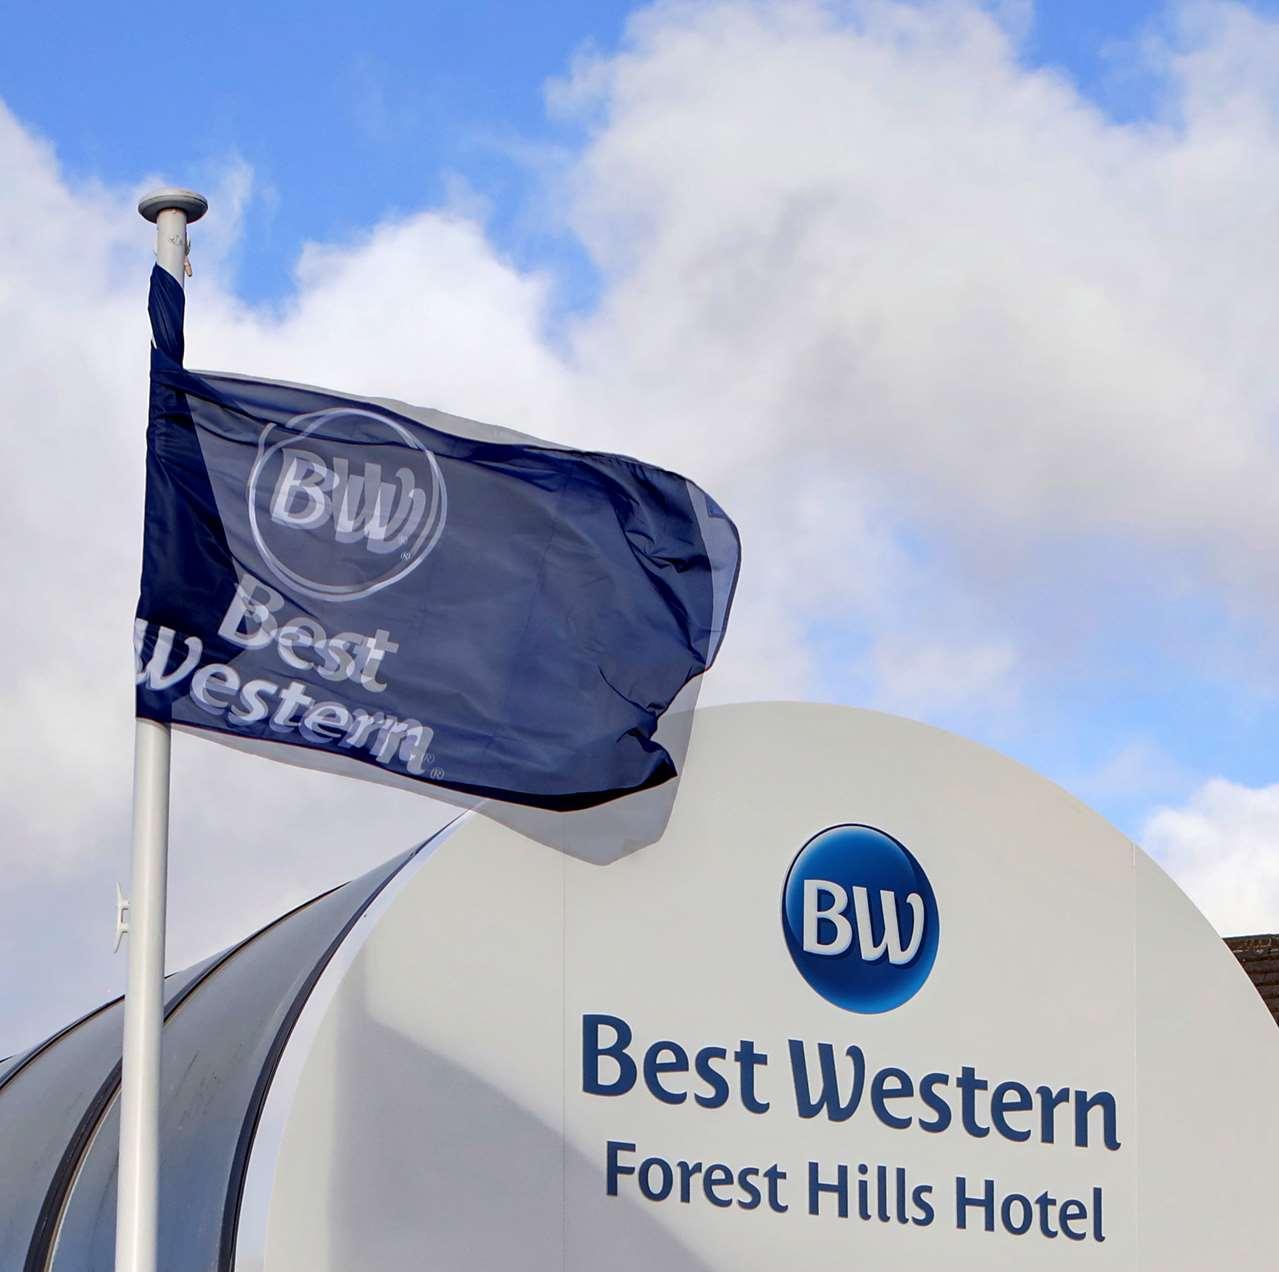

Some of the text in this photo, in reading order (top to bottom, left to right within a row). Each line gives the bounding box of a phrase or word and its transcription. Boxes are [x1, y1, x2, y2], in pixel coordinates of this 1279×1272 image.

[270, 448, 425, 557] BW
[216, 572, 399, 692] Best
[133, 615, 436, 780] Western
[802, 878, 927, 966] BW
[581, 1013, 1122, 1152] Best Western
[605, 1139, 1106, 1243] Forest Hills Hotel
